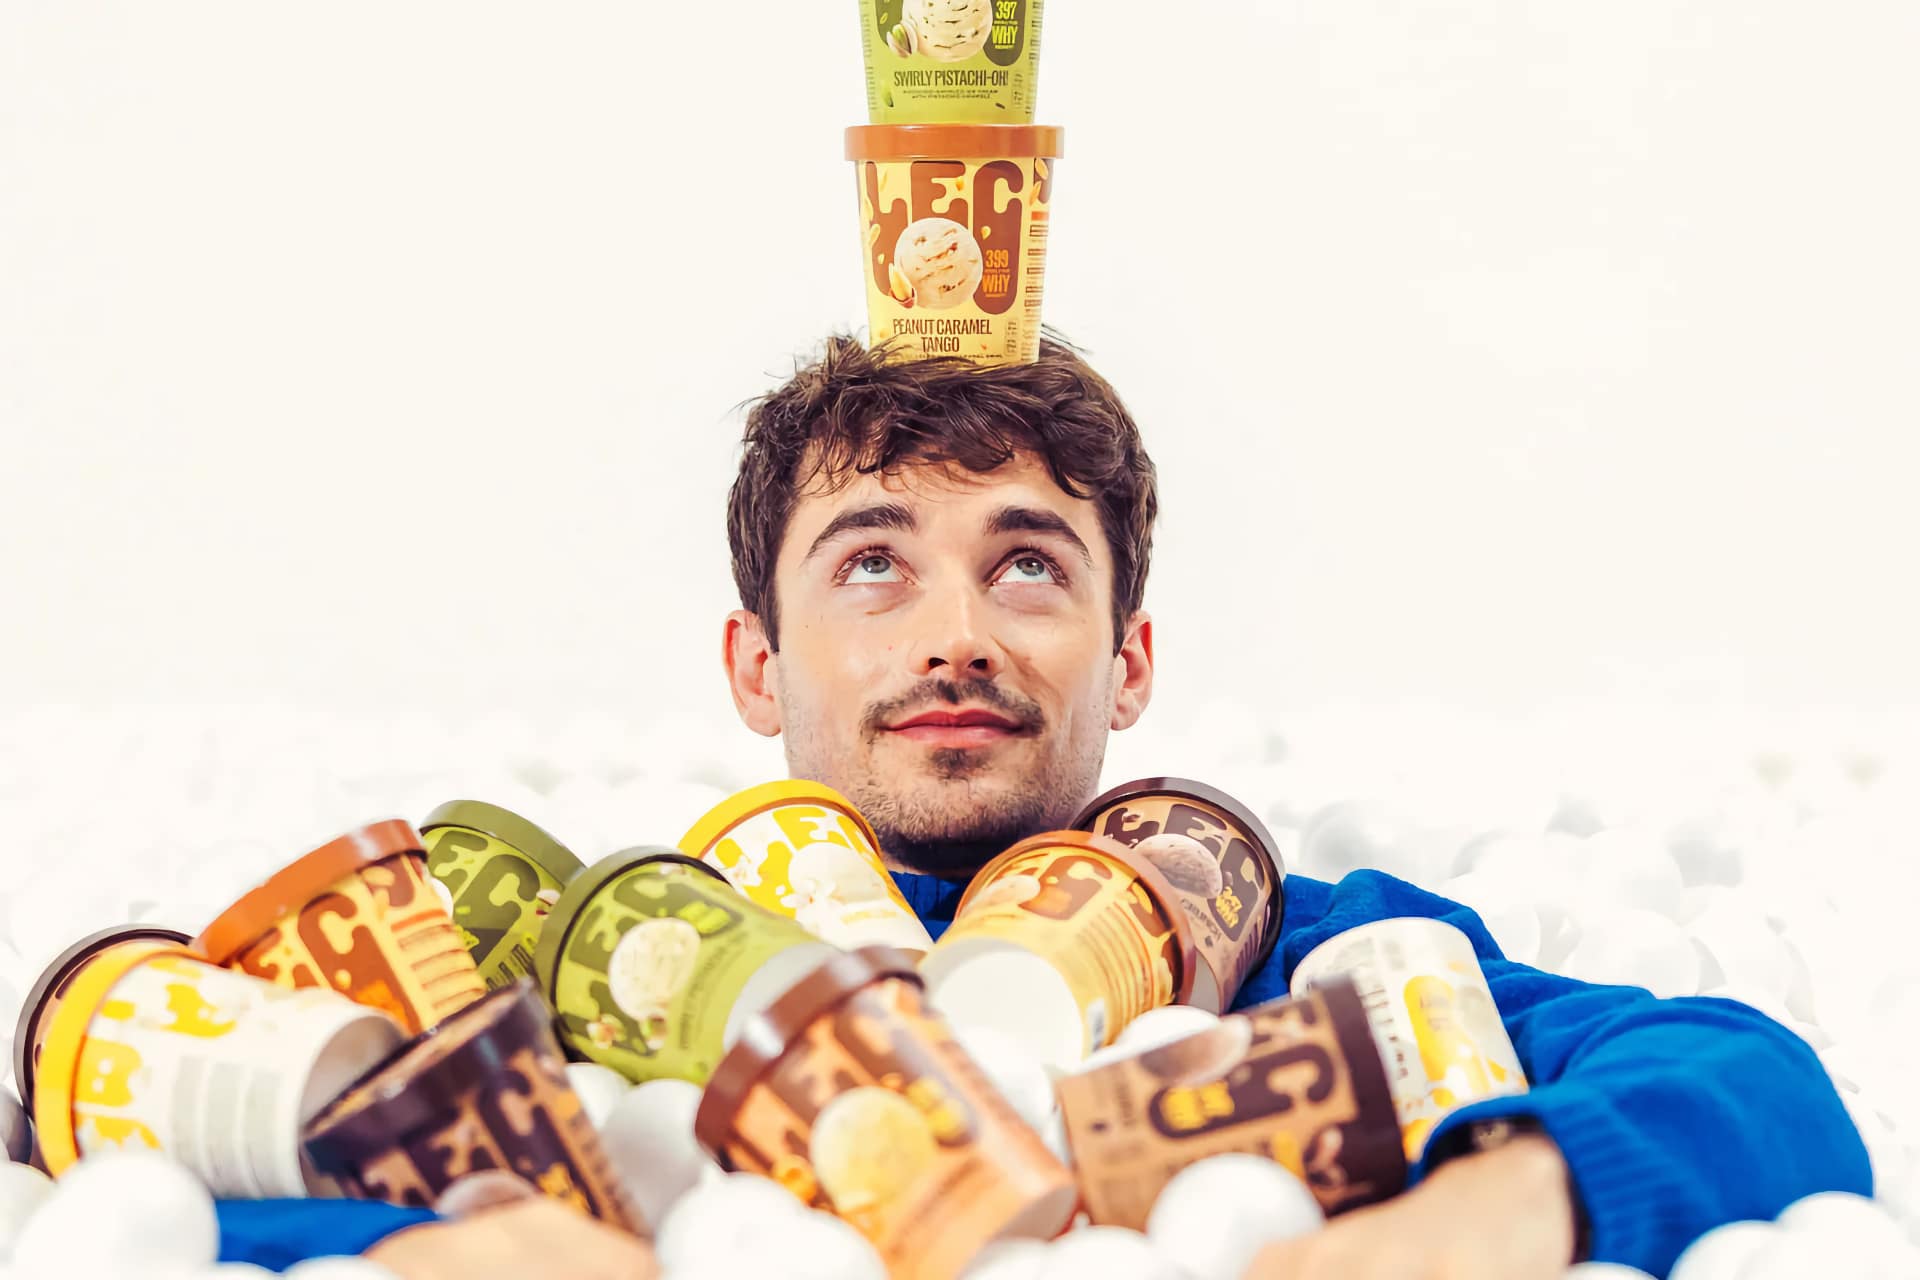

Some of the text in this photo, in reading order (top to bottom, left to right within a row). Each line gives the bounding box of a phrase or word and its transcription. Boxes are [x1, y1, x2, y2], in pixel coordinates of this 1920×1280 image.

[995, 1, 1016, 20] 397
[991, 25, 1018, 45] WHY
[893, 70, 1009, 87] SWIRLY PISTACHI-OH!
[985, 249, 1009, 268] 399
[982, 273, 1011, 293] WHY
[892, 318, 993, 335] PEANUT CARAMEL
[921, 336, 960, 353] TANGO
